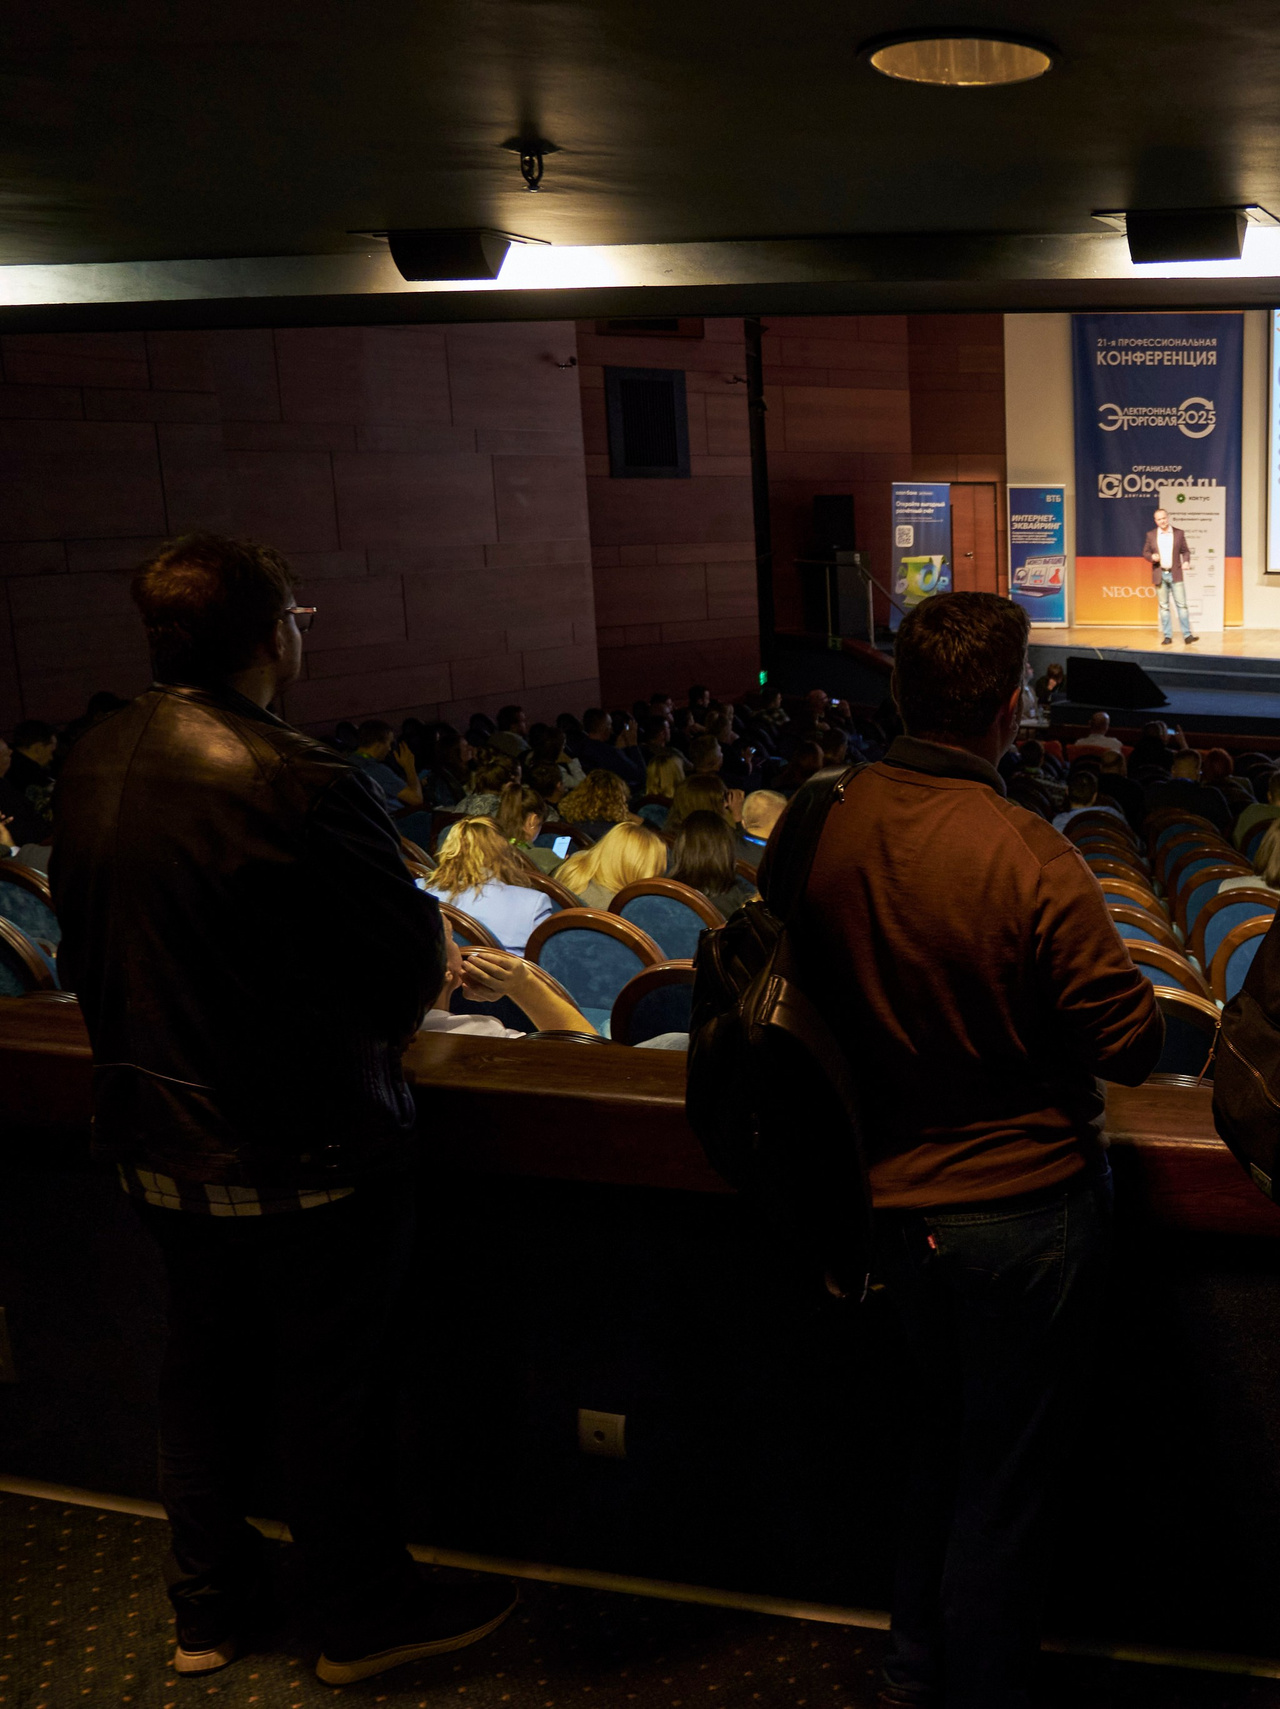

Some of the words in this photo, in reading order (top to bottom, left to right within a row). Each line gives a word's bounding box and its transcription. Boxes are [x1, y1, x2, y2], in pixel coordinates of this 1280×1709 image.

[1097, 339, 1116, 347] 21-я
[1118, 338, 1217, 347] ПРОФЕССИОНАЛЬНАЯ
[1097, 351, 1217, 367] КОНФЕРЕНЦИЯ
[1177, 411, 1216, 424] 2025
[1132, 465, 1182, 473] ОРГАНИЗАТОР
[1046, 495, 1061, 503] ВТБ
[1012, 514, 1056, 522] ИНТЕРНЕТ-
[1012, 521, 1062, 530] ЭКВАЙРИНГ
